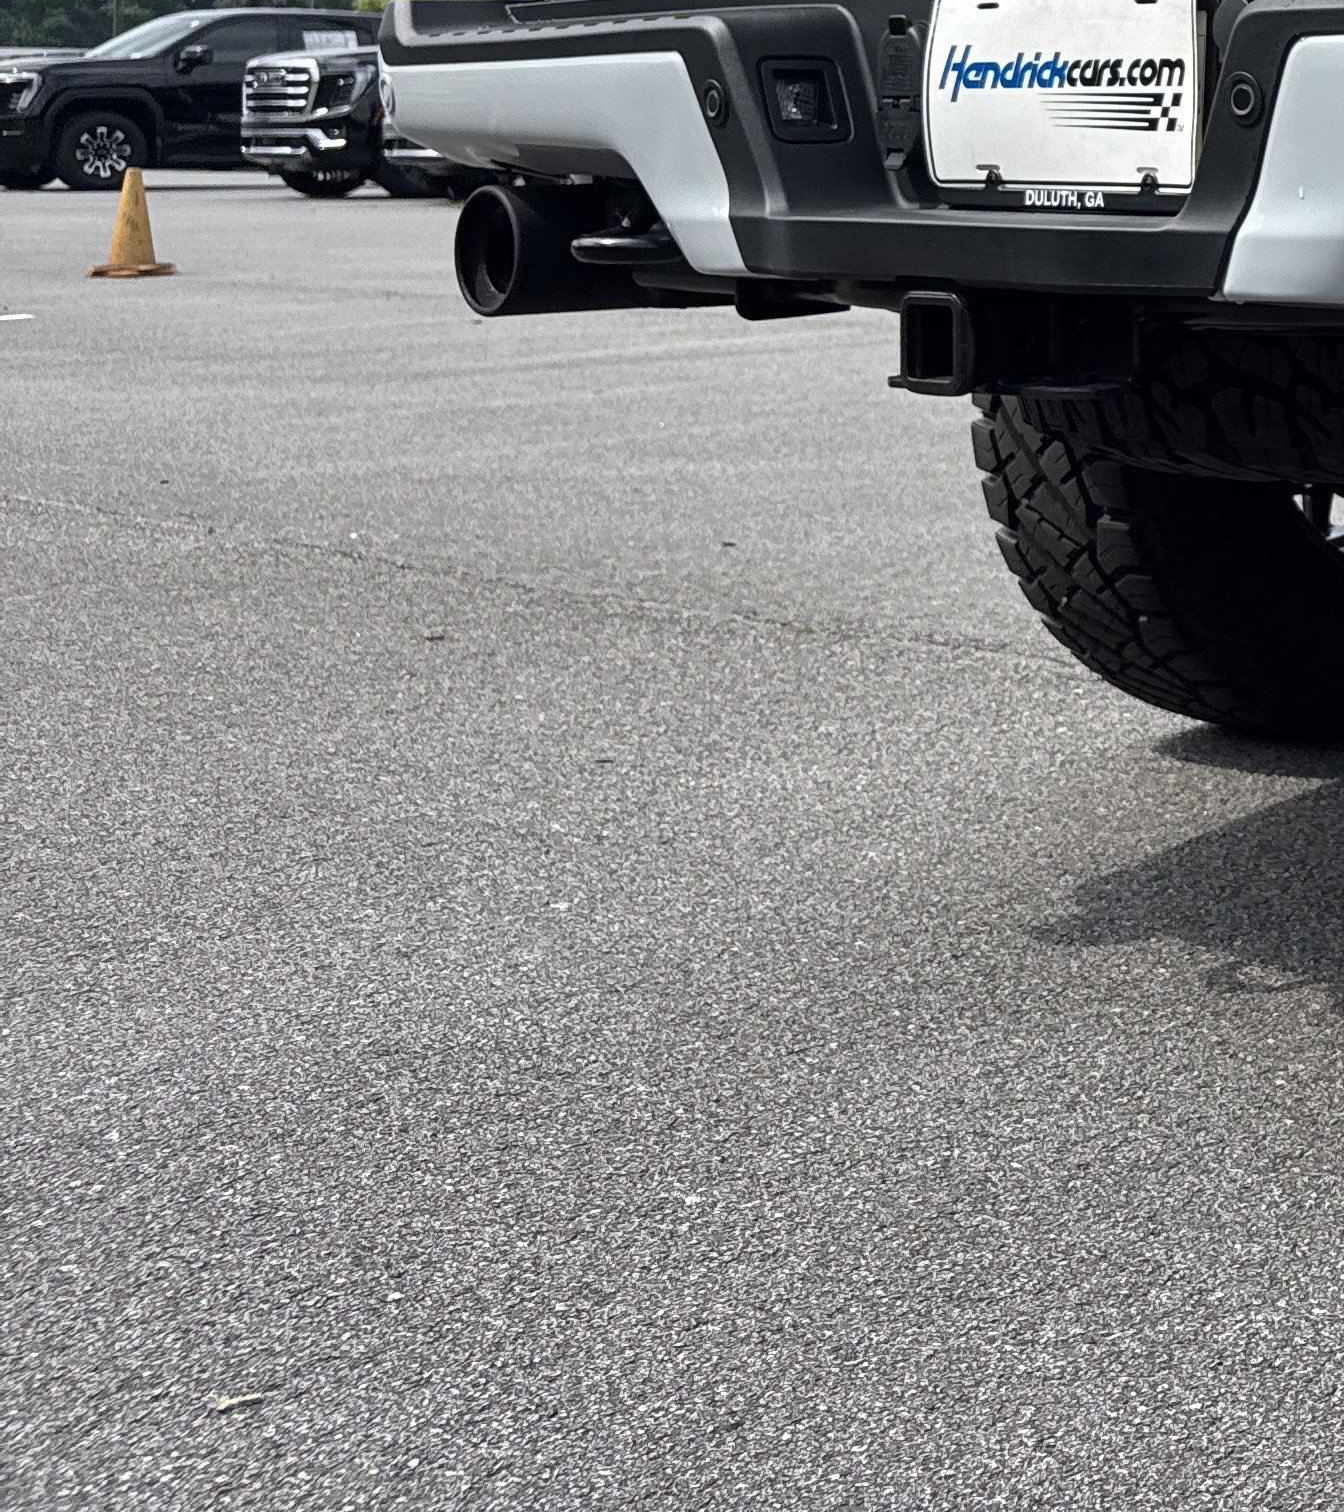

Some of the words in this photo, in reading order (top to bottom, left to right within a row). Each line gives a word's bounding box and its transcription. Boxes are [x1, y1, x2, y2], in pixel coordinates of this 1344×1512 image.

[938, 44, 1187, 103] Hendrickcars.com
[1025, 189, 1081, 209] DULUTH,
[1085, 191, 1105, 208] GA
